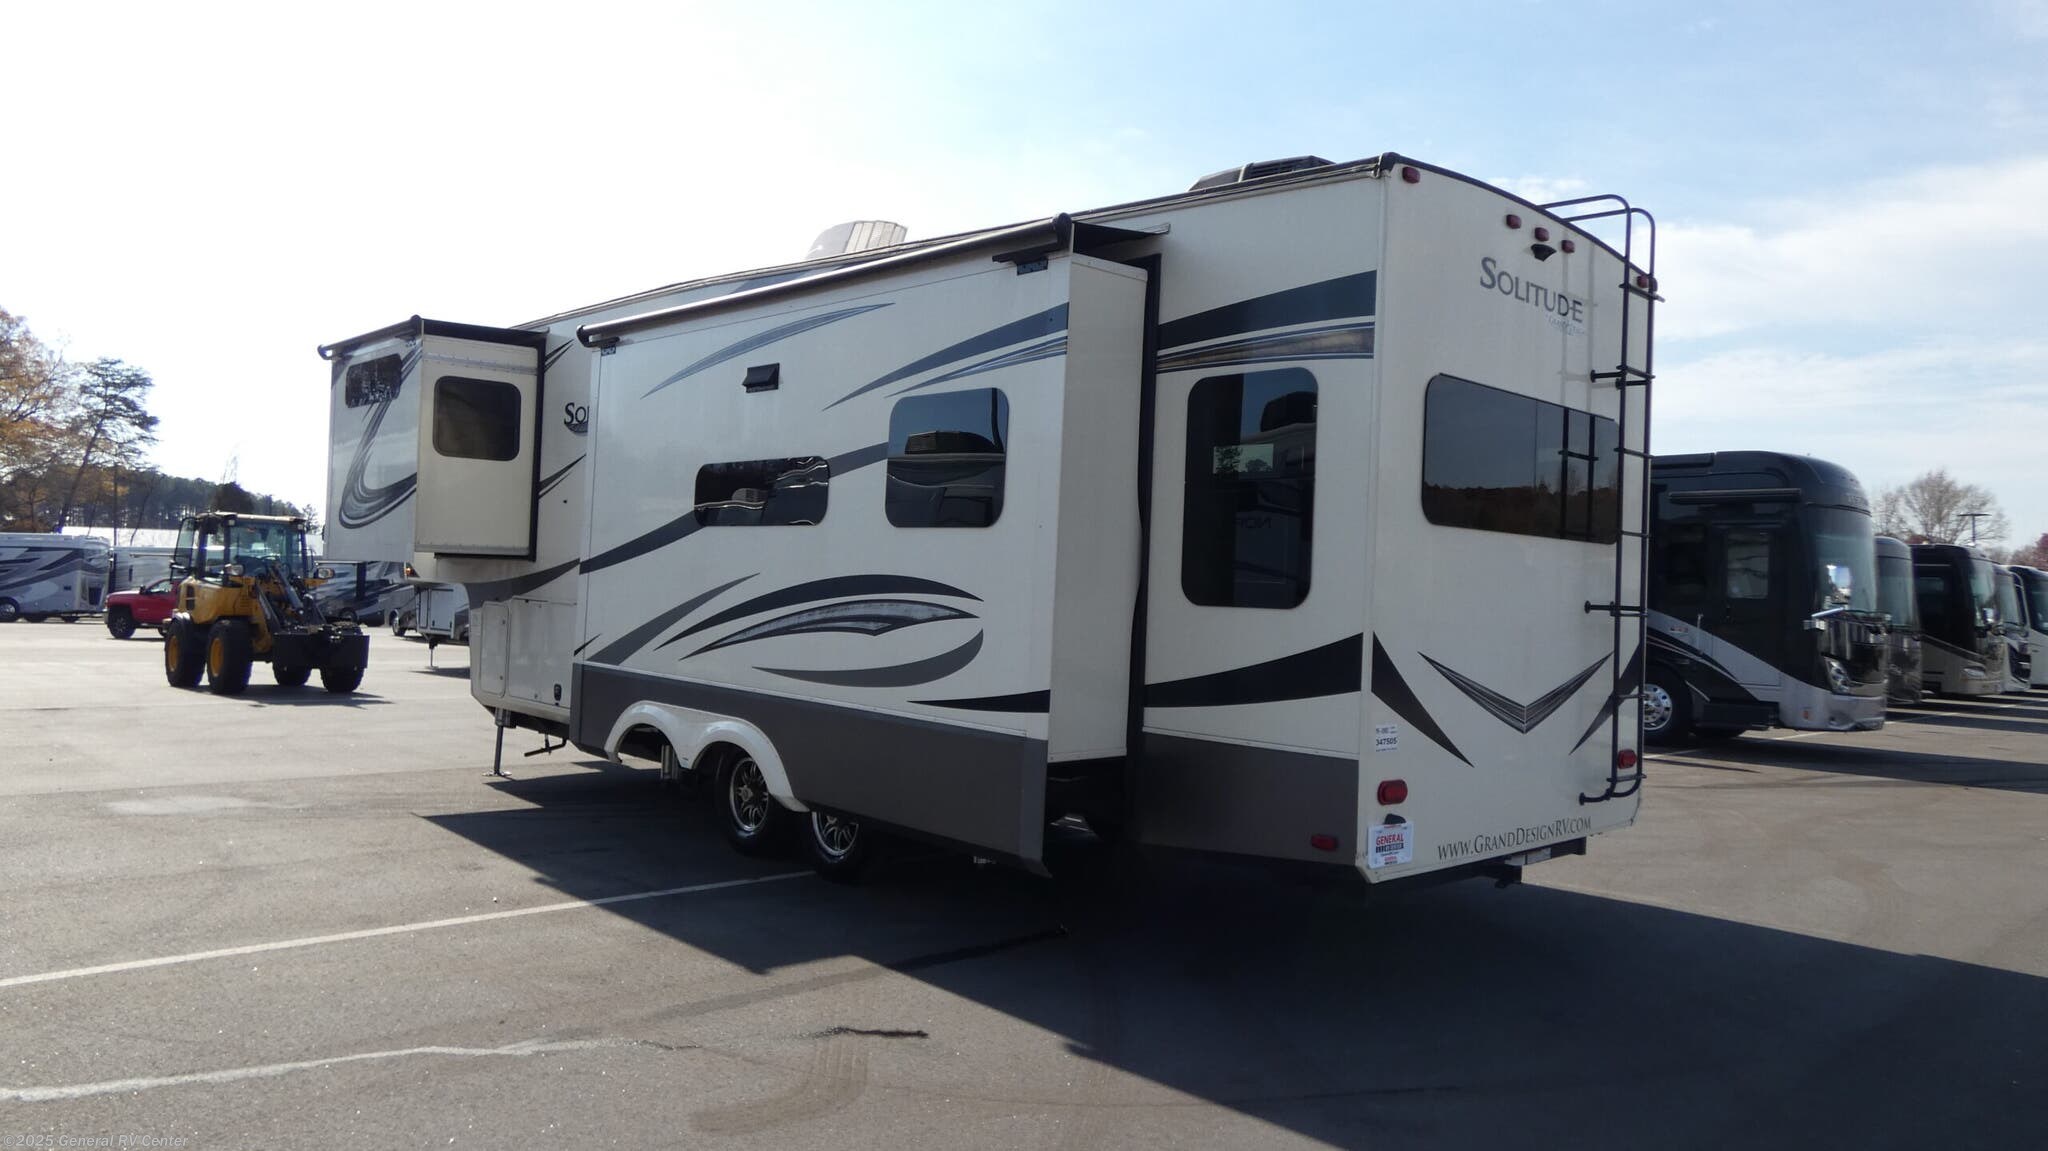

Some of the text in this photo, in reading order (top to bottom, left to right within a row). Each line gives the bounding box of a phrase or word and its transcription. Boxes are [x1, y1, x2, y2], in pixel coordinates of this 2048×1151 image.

[1480, 256, 1583, 323] SOLITUDE
[1376, 833, 1405, 845] GENERAL
[1437, 816, 1592, 860] WWW.GRANDDESIGNRV.COM
